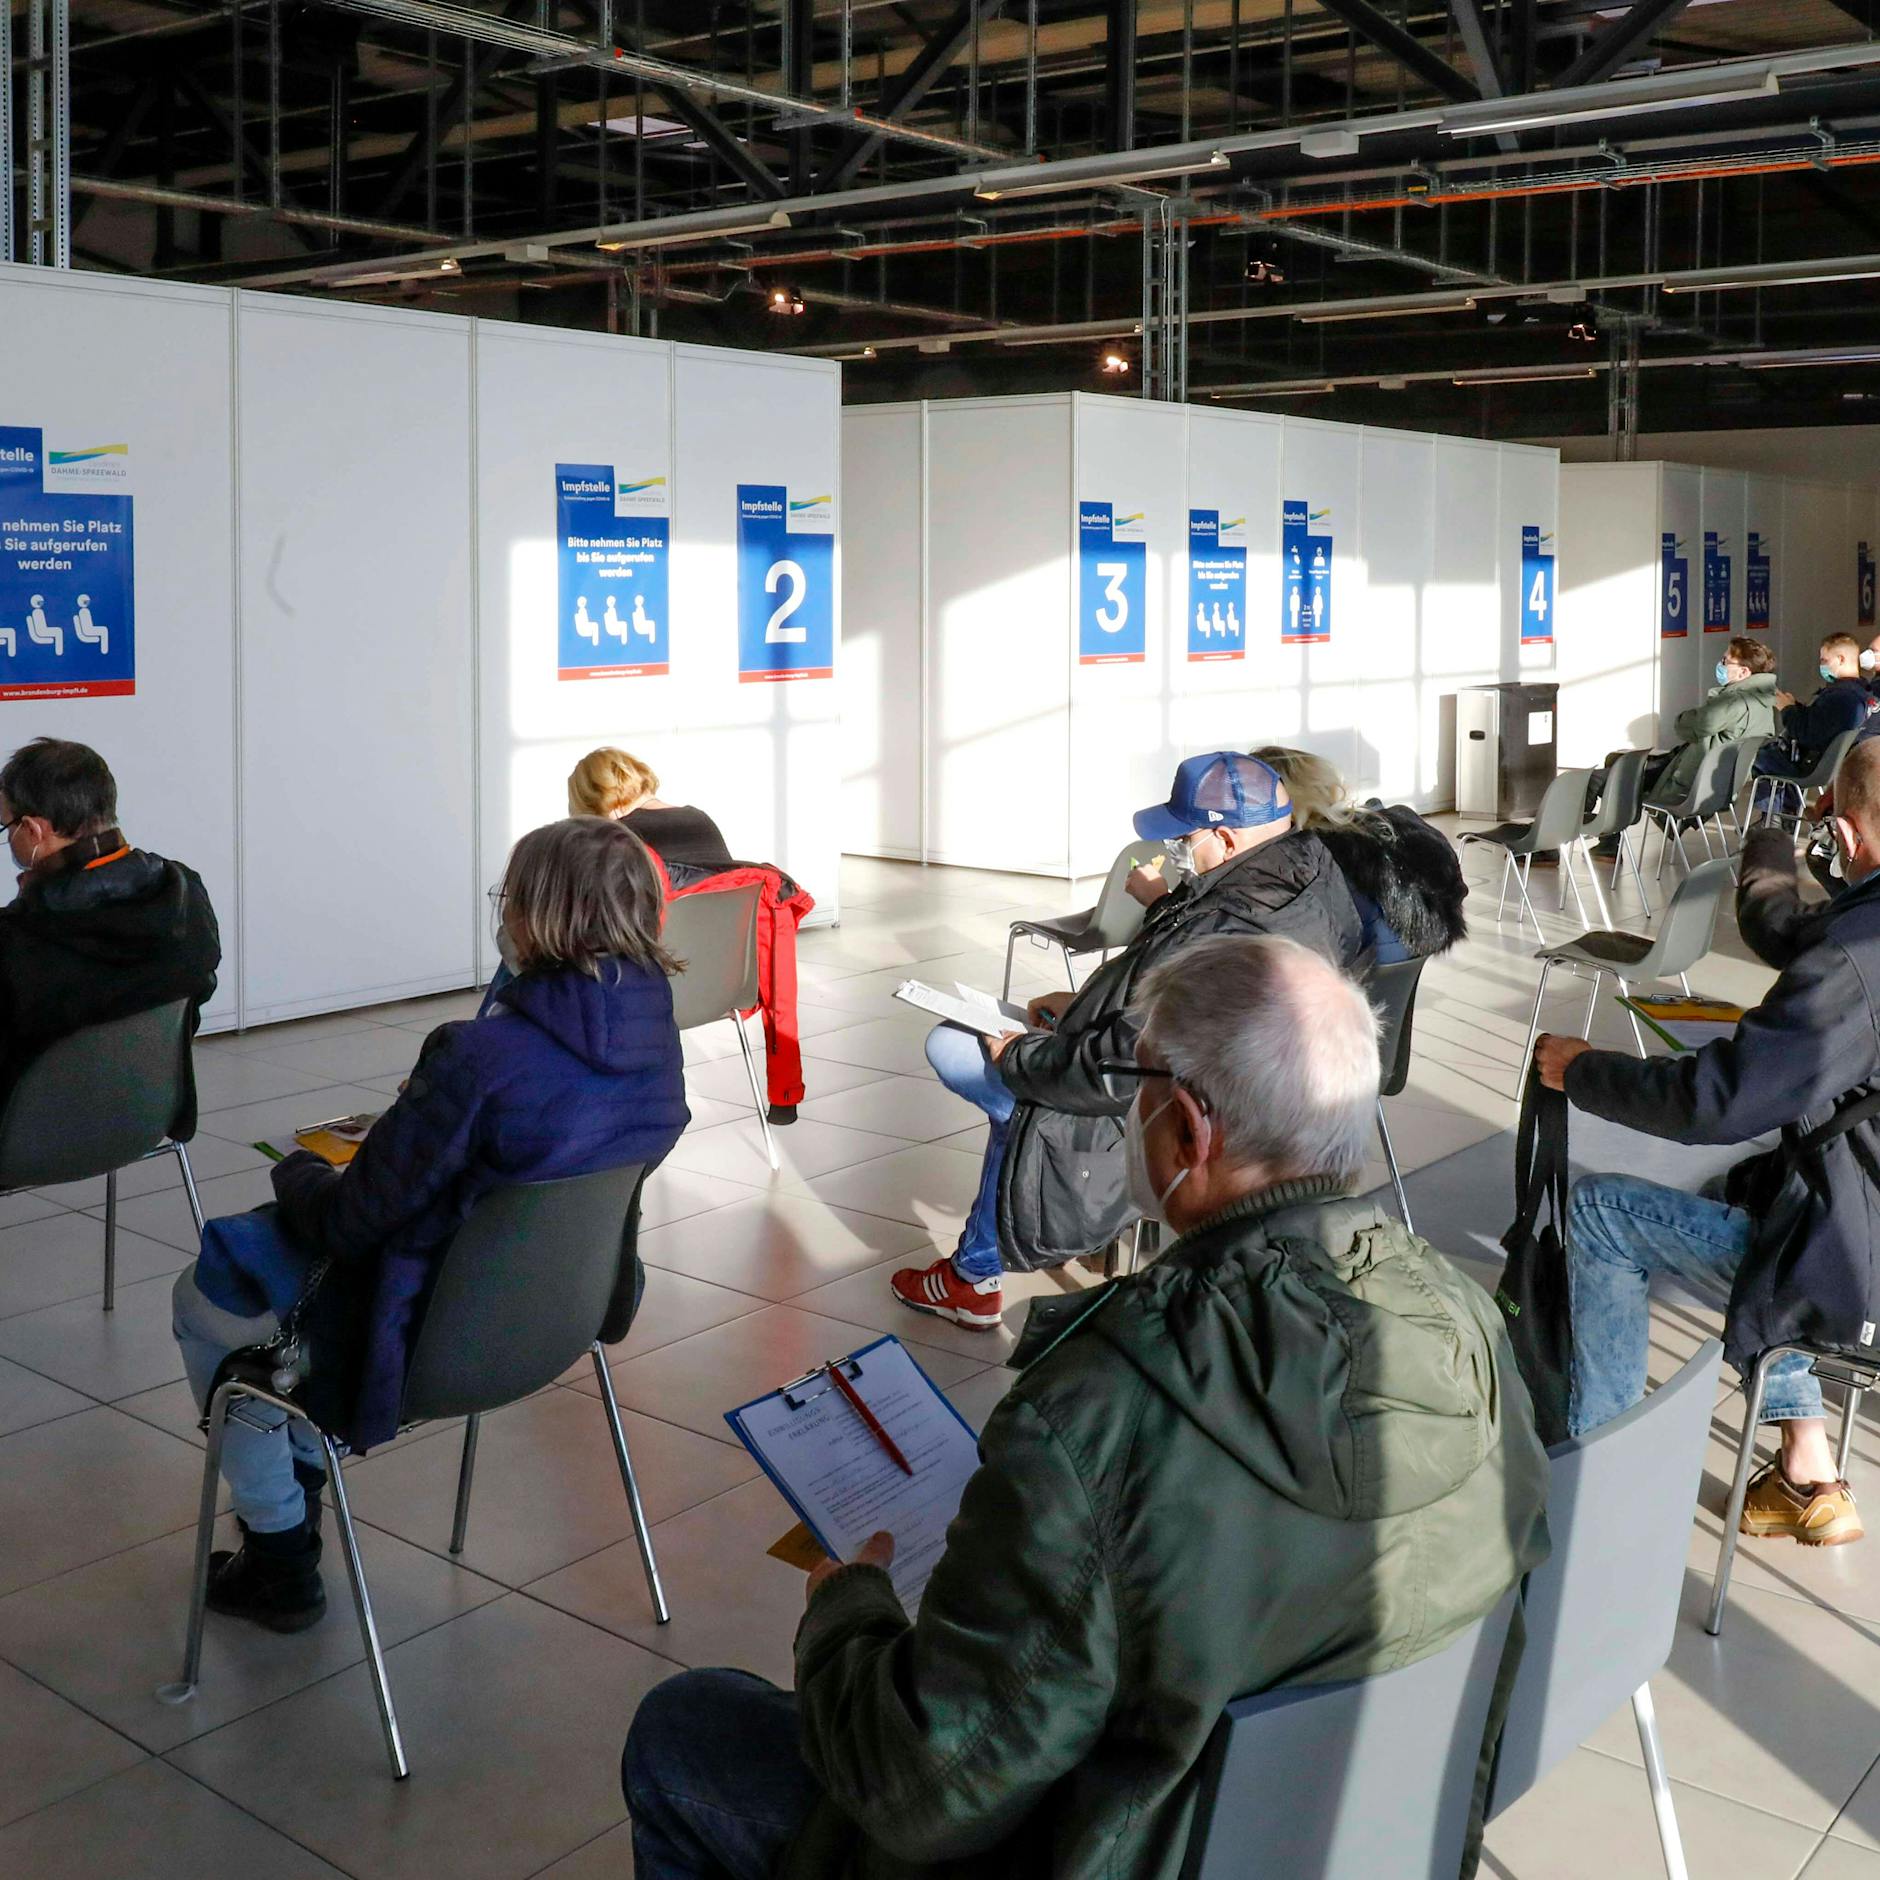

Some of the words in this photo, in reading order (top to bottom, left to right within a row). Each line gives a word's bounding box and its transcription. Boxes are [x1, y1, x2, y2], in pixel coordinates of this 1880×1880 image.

[562, 480, 611, 494] Impfstelle
[741, 500, 783, 513] Impfstelle
[2, 519, 59, 532] nehmen
[63, 519, 85, 533] Sie
[88, 520, 122, 533] Platz
[4, 538, 27, 551] Sie
[30, 538, 108, 554] aufgerufen
[567, 537, 589, 548] Bitte
[590, 537, 625, 548] nehmen
[626, 537, 640, 548] Sie
[641, 537, 663, 548] Platz
[18, 557, 72, 570] werden
[591, 552, 606, 563] Sie
[606, 552, 655, 565] aufgerufen
[598, 567, 633, 578] werden
[1095, 562, 1129, 633] 3
[1529, 570, 1548, 621] 4
[1667, 572, 1681, 618] 5
[1862, 573, 1872, 610] 6
[765, 559, 807, 644] 2
